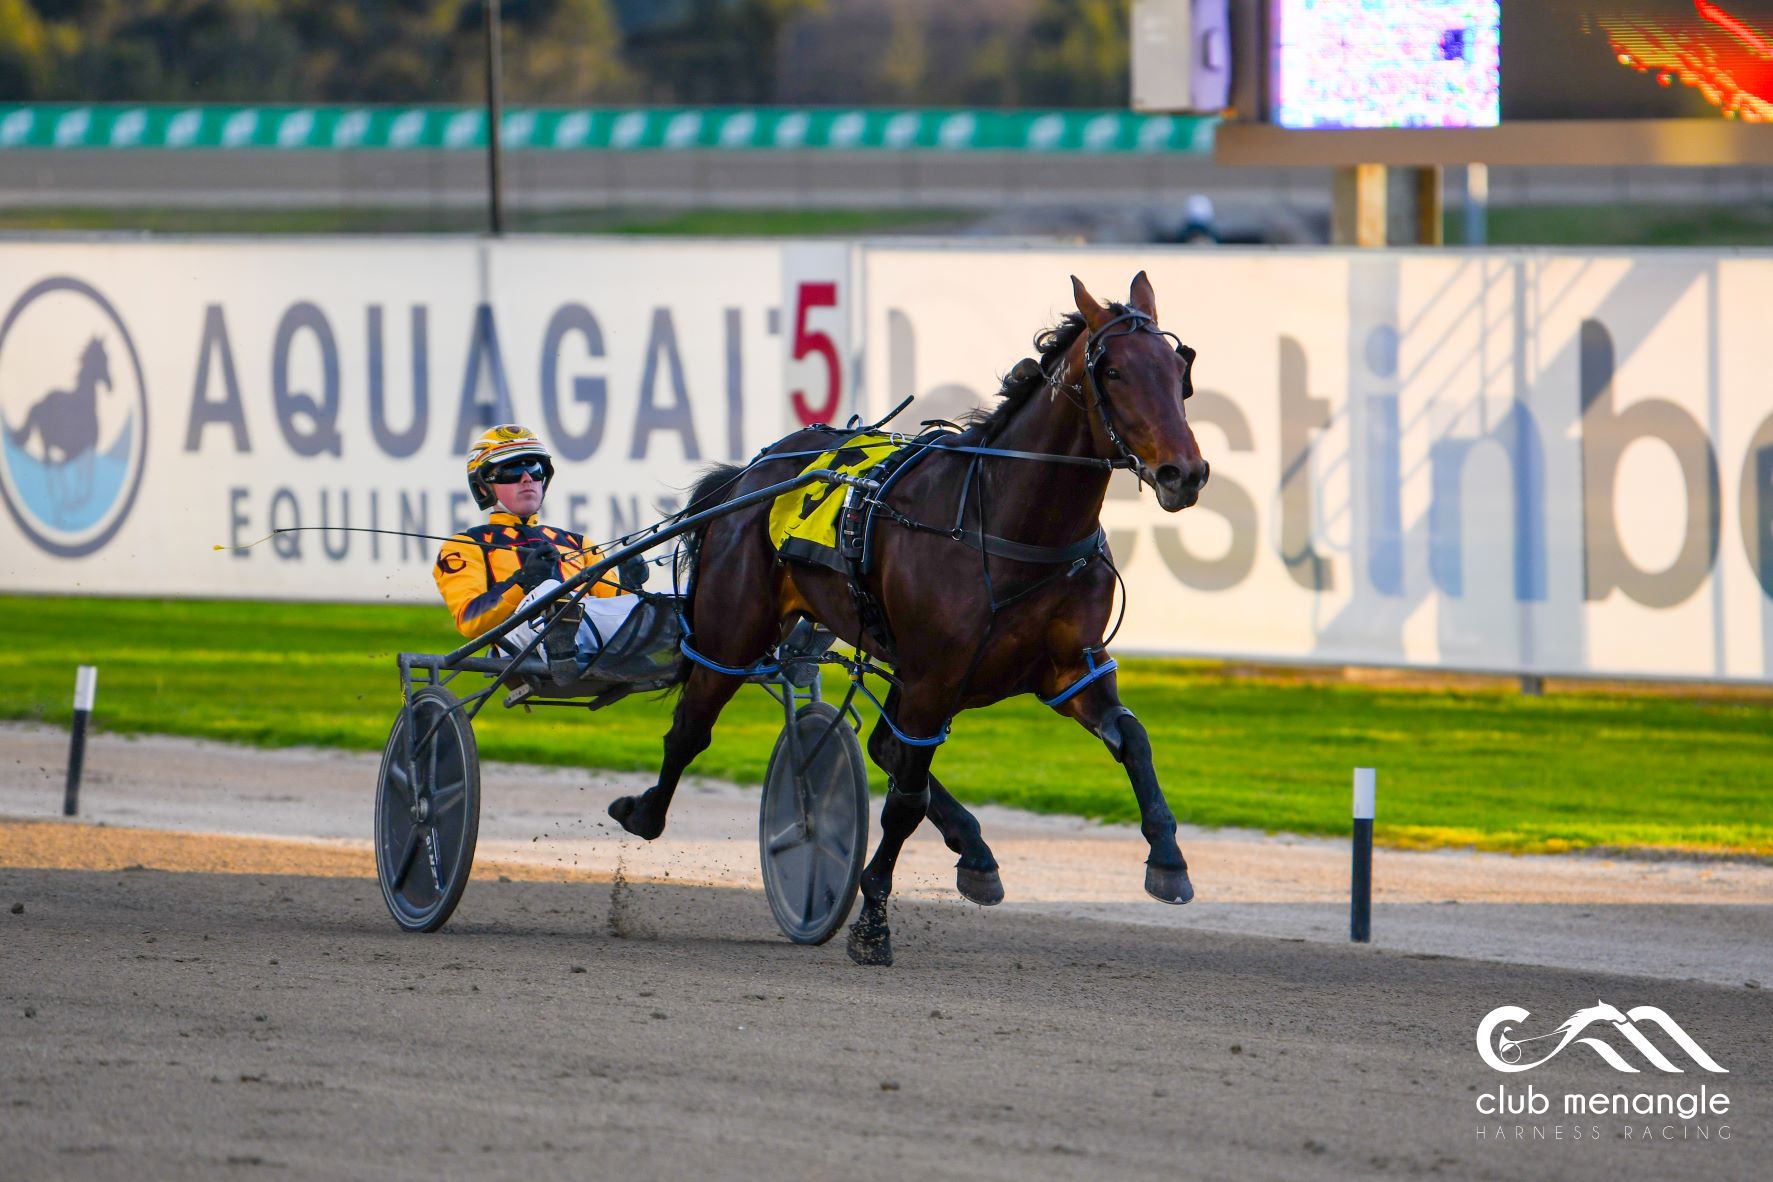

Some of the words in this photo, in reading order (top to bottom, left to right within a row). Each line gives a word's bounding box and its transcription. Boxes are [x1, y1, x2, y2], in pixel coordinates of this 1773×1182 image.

[184, 300, 781, 464] AQUAGAI
[790, 281, 842, 430] 5
[230, 487, 470, 564] EQUINE
